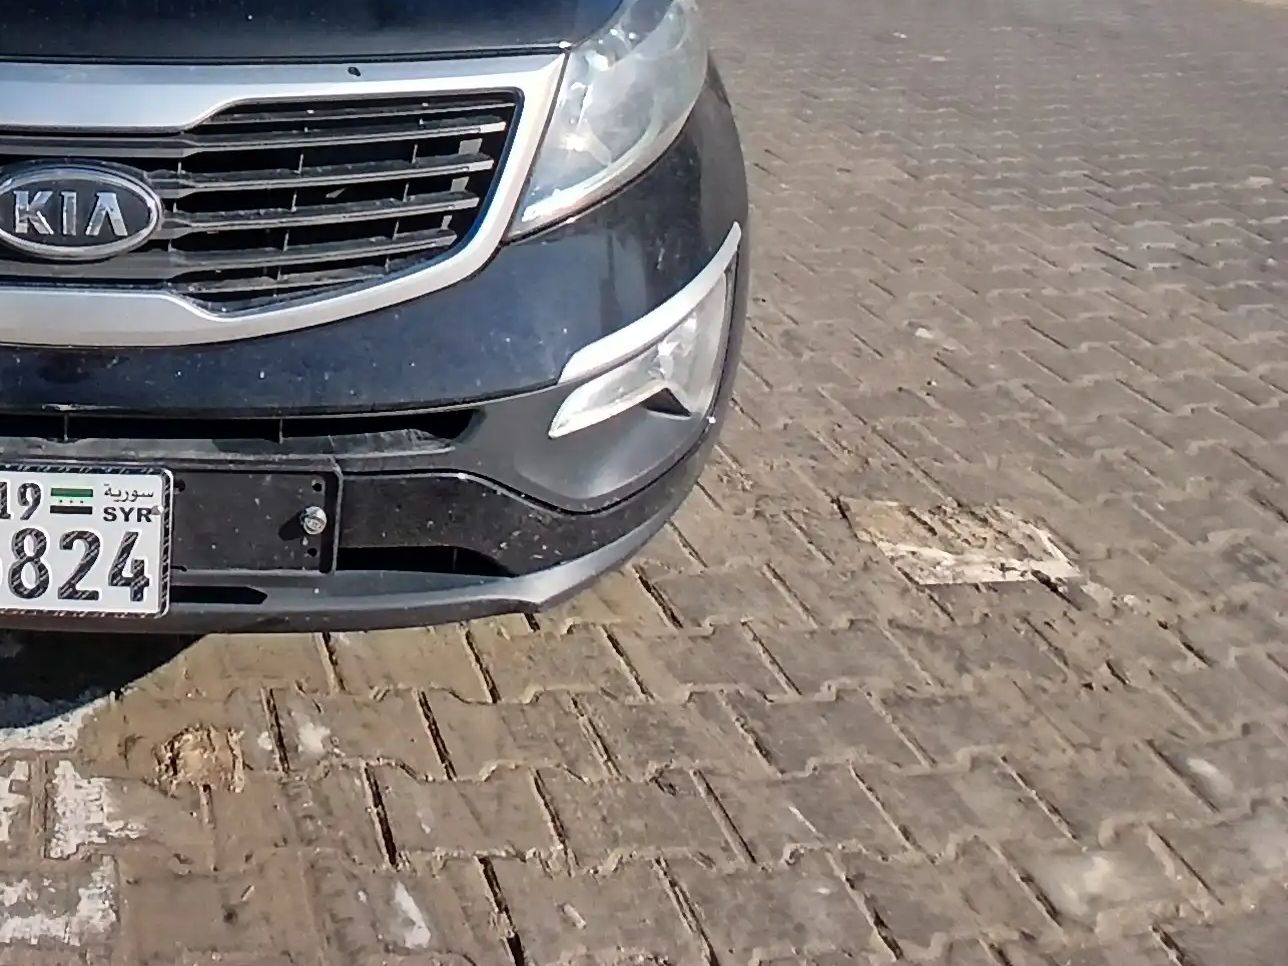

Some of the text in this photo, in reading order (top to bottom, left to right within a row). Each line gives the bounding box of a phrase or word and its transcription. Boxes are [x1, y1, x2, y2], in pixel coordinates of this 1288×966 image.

[13, 190, 128, 236] KIA
[103, 483, 155, 503] سورية
[103, 506, 153, 523] SYR
